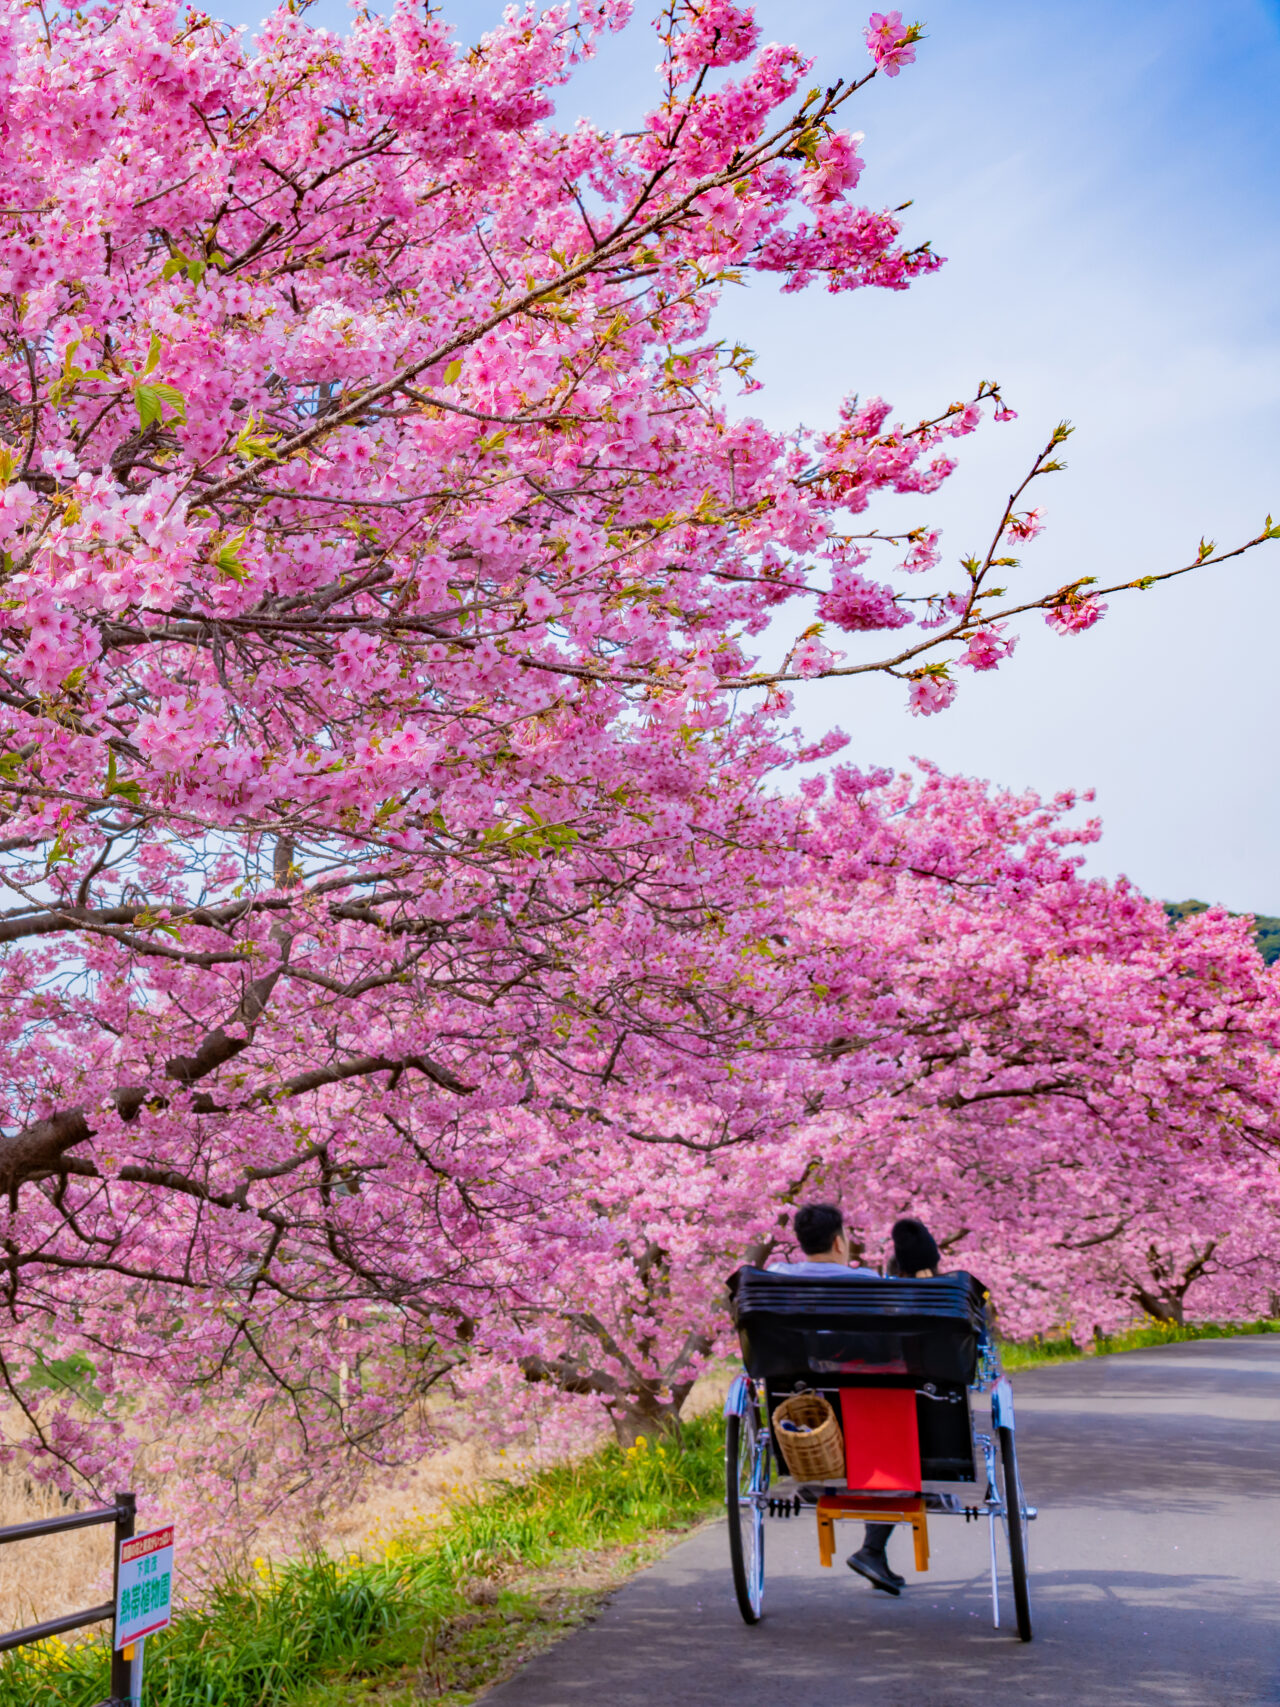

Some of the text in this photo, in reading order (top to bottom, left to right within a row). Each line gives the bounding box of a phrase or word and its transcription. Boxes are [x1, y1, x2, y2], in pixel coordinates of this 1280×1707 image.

[120, 1572, 170, 1625] 熱帯植物園
